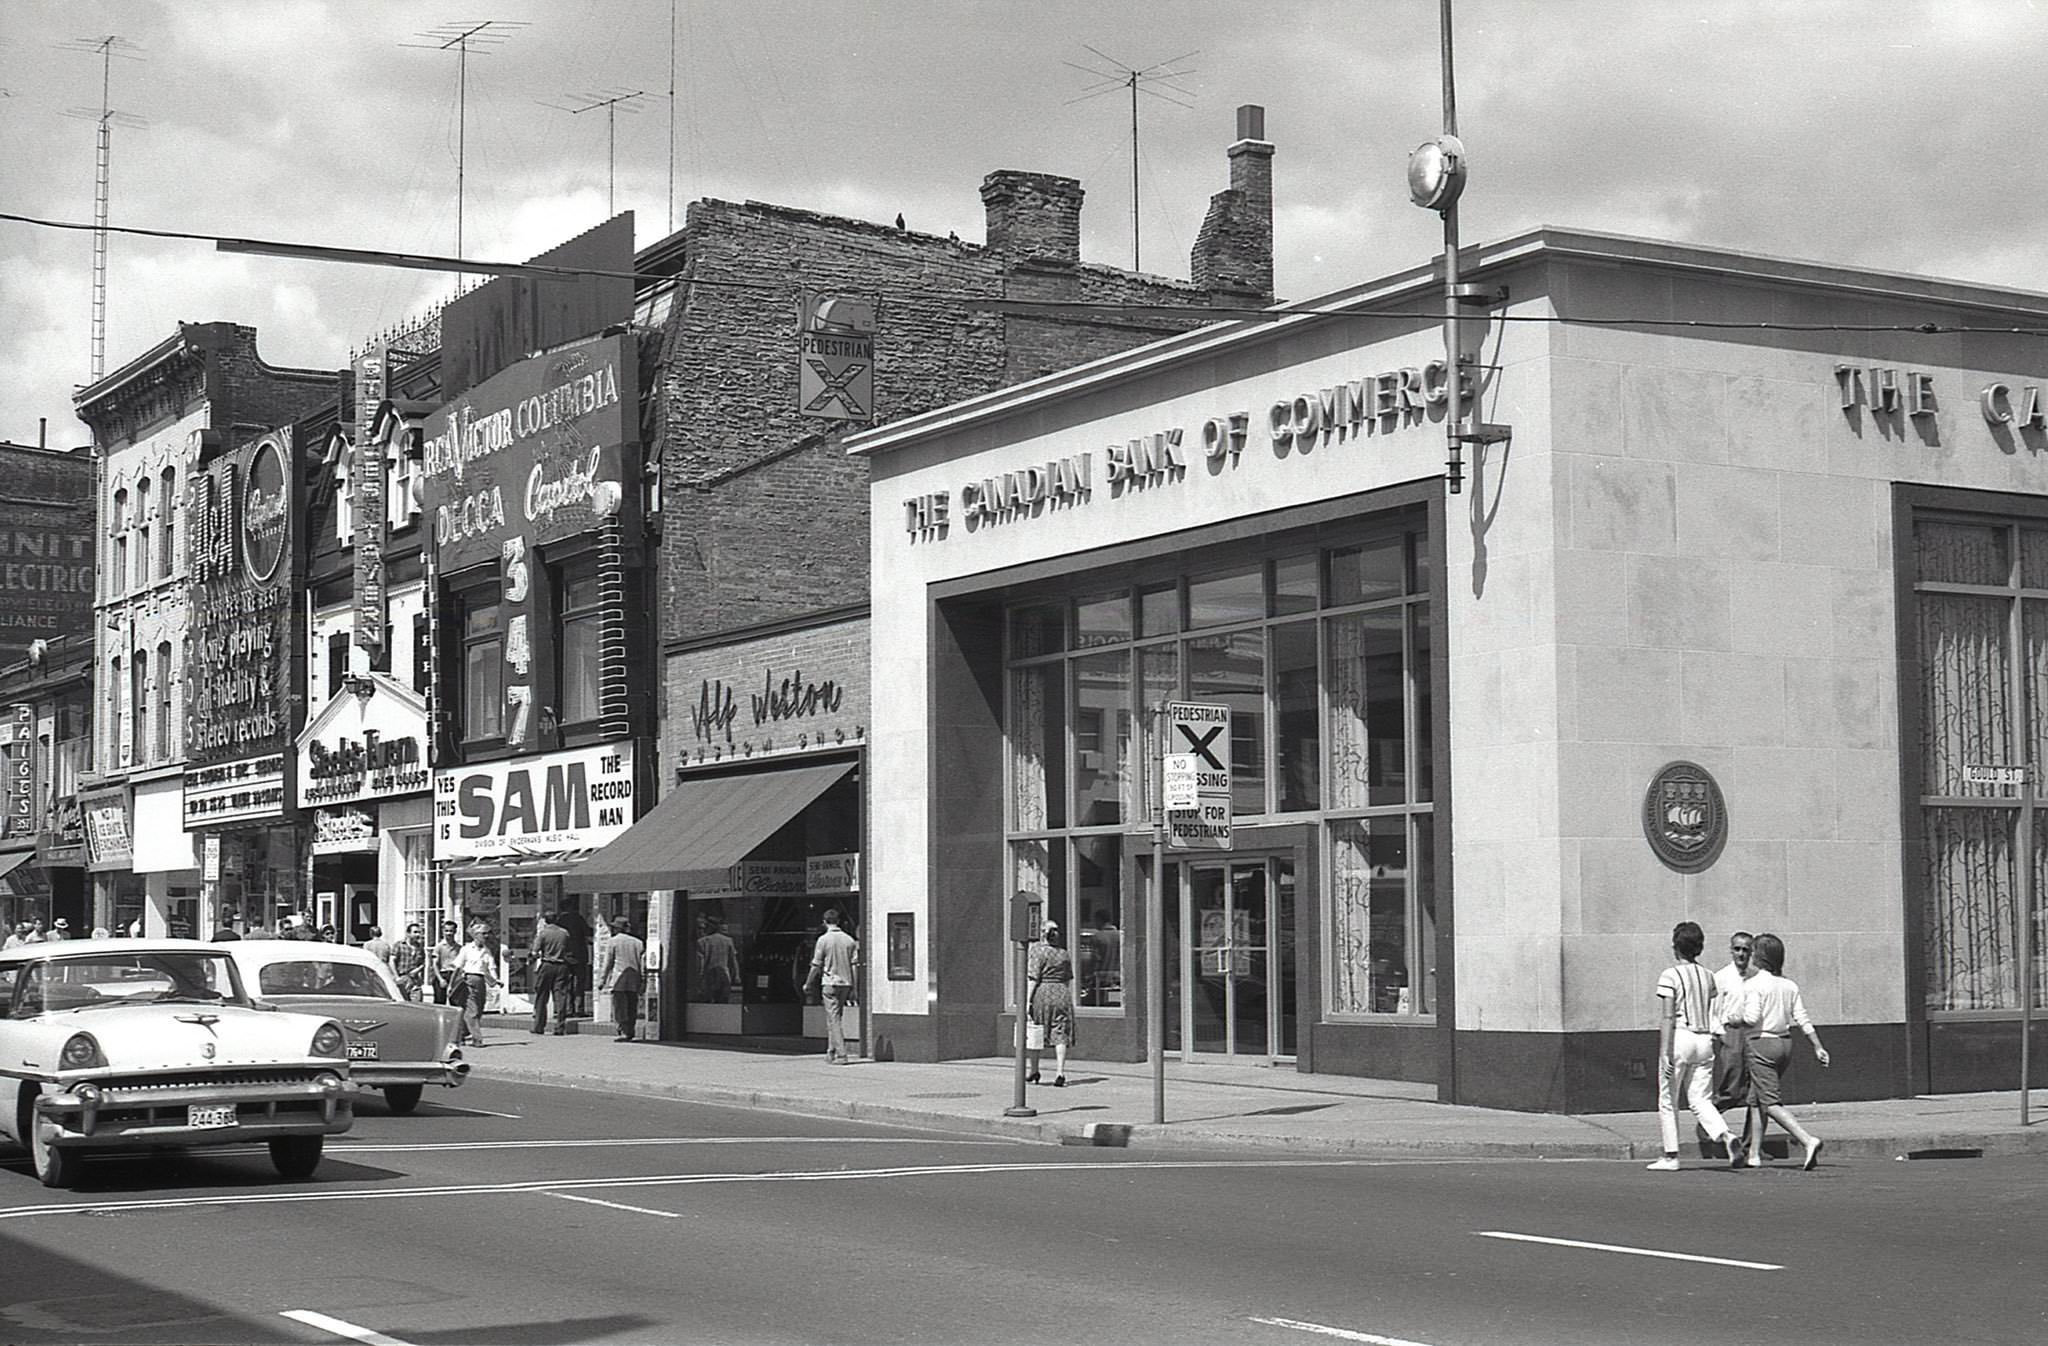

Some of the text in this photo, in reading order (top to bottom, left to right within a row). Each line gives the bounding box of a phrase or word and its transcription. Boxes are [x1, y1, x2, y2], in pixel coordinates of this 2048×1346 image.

[803, 338, 873, 359] PEDESTRIAN
[517, 364, 618, 437] COLUMBIA
[1834, 363, 1936, 417] THE
[904, 489, 950, 533] THE
[961, 452, 1093, 517] CANADIAN
[1106, 427, 1187, 484] BANK
[1203, 410, 1251, 458] OF
[525, 445, 600, 521] Capitol
[436, 486, 505, 547] DECCA
[0, 563, 92, 592] ECTRIC
[0, 615, 57, 628] LIANCE
[229, 621, 273, 668] playing
[502, 536, 534, 746] 347
[234, 701, 277, 743] records
[1172, 706, 1227, 722] PEDESTRIAN
[600, 754, 622, 774] THE
[1173, 760, 1187, 770] NO
[437, 776, 455, 794] YES
[590, 780, 632, 802] RECORD
[1196, 773, 1228, 788] SSING
[436, 800, 456, 817] THIS
[458, 761, 591, 839] SAM
[598, 807, 624, 827] MAN
[1174, 806, 1226, 820] STOP FOR
[440, 823, 450, 840] IS
[1172, 823, 1230, 839] PEDESTRIANS
